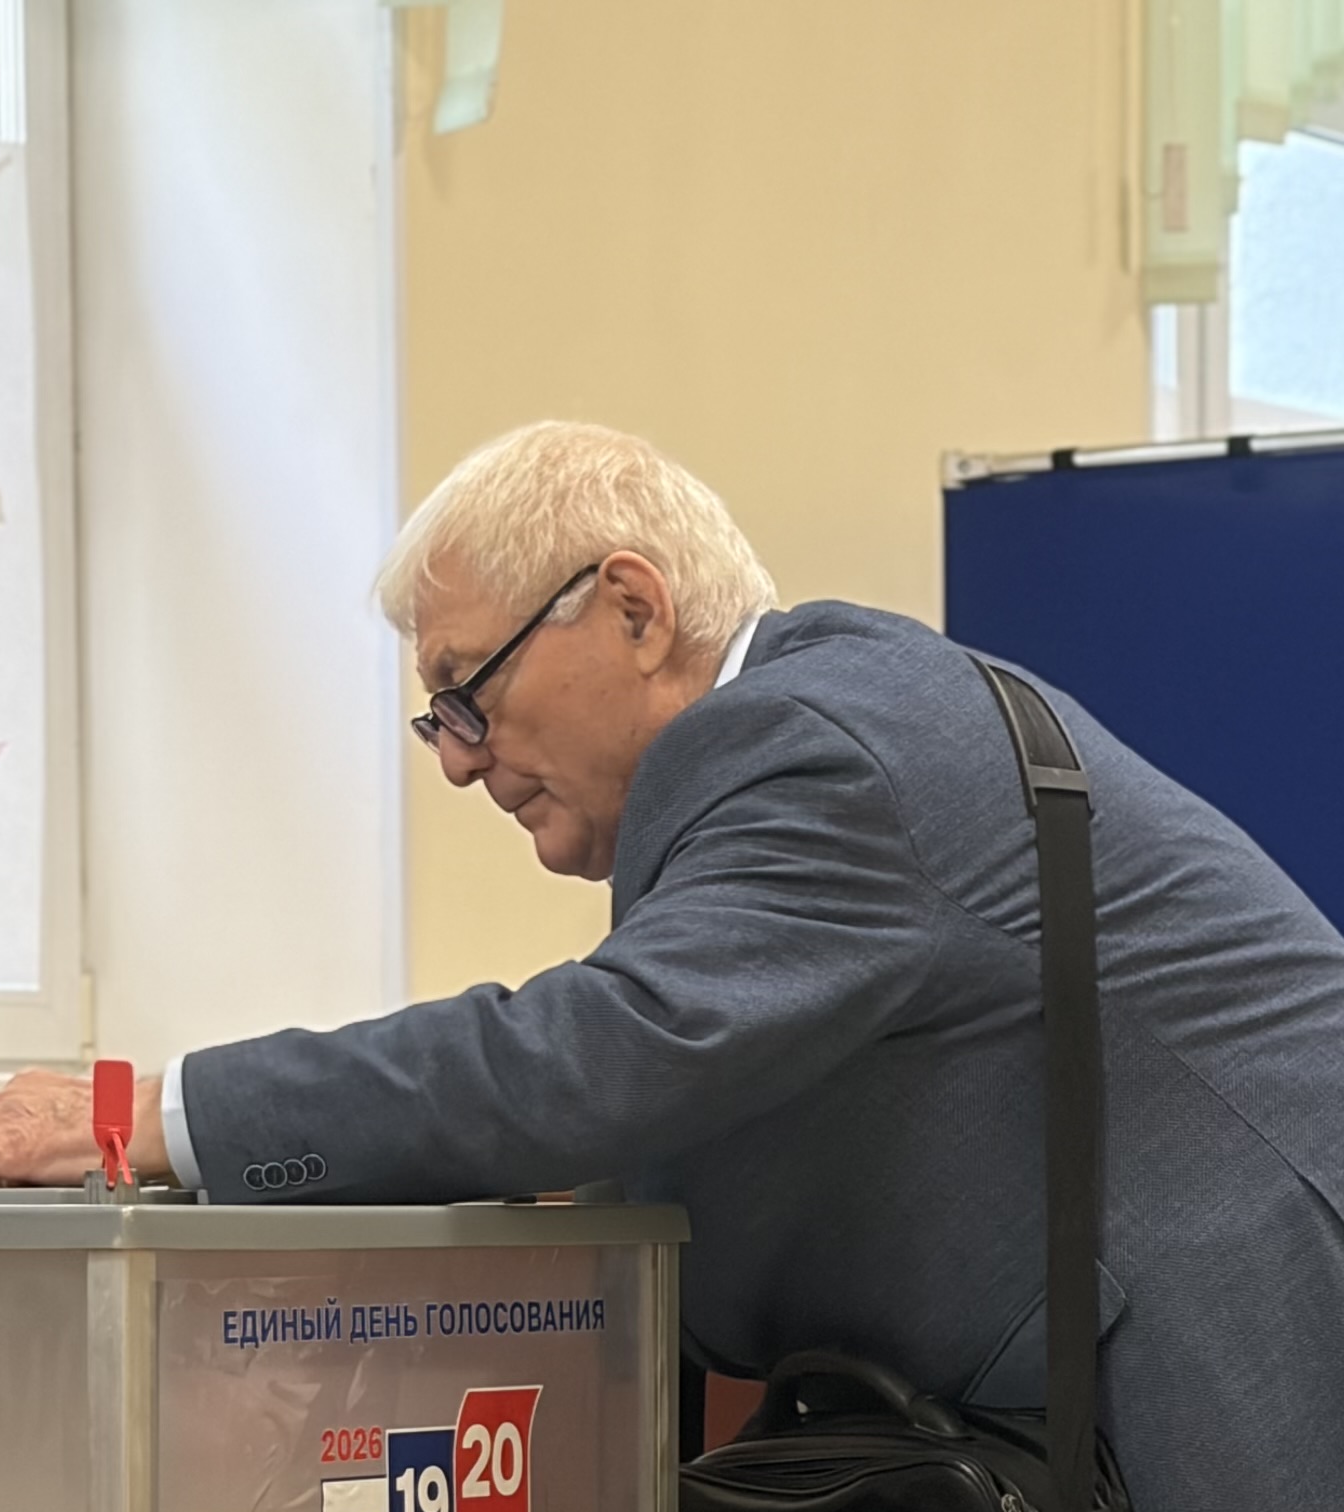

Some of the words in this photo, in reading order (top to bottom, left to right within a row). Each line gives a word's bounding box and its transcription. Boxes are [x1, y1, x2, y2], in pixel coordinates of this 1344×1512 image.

[223, 1297, 342, 1349] ЕДИНЫЙ
[350, 1305, 418, 1344] ДЕНЬ
[426, 1300, 605, 1335] ГОЛОСОВАНИЯ
[321, 1427, 382, 1462] 2026
[462, 1422, 523, 1498] 20
